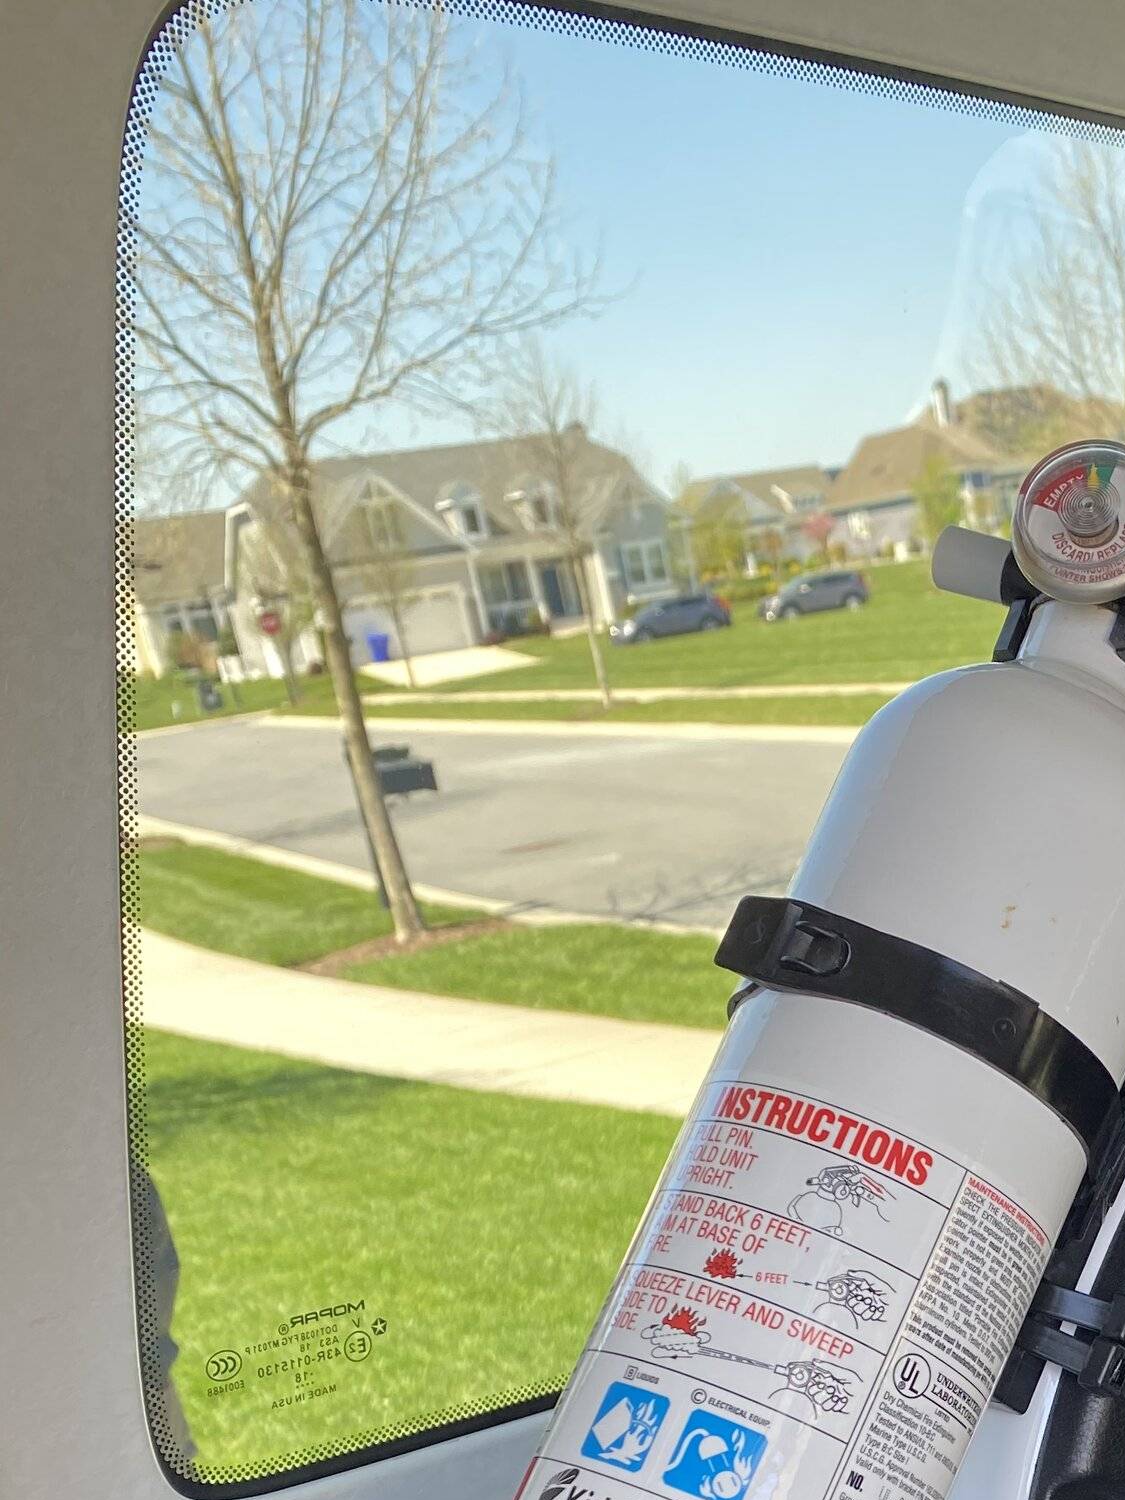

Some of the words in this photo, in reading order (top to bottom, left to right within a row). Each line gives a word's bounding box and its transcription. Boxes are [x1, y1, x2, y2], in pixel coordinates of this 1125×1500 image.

[712, 1086, 933, 1186] INSTRUCTIONS
[725, 1127, 754, 1149] PIN.
[719, 1147, 759, 1171] UNIT
[959, 1196, 981, 1214] SPECT
[963, 1186, 986, 1206] CHECK
[987, 1201, 1000, 1217] THE
[968, 1177, 1017, 1216] MAINTENANCE
[664, 1194, 704, 1214] STAND
[704, 1199, 745, 1224] BACK
[750, 1213, 762, 1230] 6
[764, 1217, 813, 1252] FEET,
[675, 1216, 699, 1235] AT
[697, 1220, 741, 1247] BASE
[742, 1233, 769, 1255] OF
[962, 1247, 986, 1268] properly
[975, 1243, 986, 1255] not
[755, 1271, 763, 1282] 6
[763, 1273, 790, 1285] FEET
[647, 1294, 667, 1314] TO
[918, 1289, 937, 1306] NFPA
[632, 1270, 686, 1296] QUEEZE
[685, 1281, 740, 1315] LEVER
[742, 1302, 785, 1330] AND
[787, 1319, 855, 1360] SWEEP
[900, 1357, 919, 1394] UL
[707, 1396, 748, 1419] ELECTRICAL
[878, 1401, 918, 1430] Classification
[882, 1390, 896, 1405] Dry
[895, 1398, 924, 1420] Chemical
[922, 1413, 933, 1427] Fire
[868, 1422, 892, 1442] Marine
[892, 1435, 907, 1451] Type
[875, 1412, 898, 1431] Tested
[896, 1425, 904, 1435] to
[864, 1432, 881, 1449] Type
[892, 1449, 906, 1463] Size
[845, 1470, 864, 1492] NO.
[855, 1455, 873, 1471] Valid
[871, 1465, 887, 1480] only
[886, 1473, 899, 1486] with
